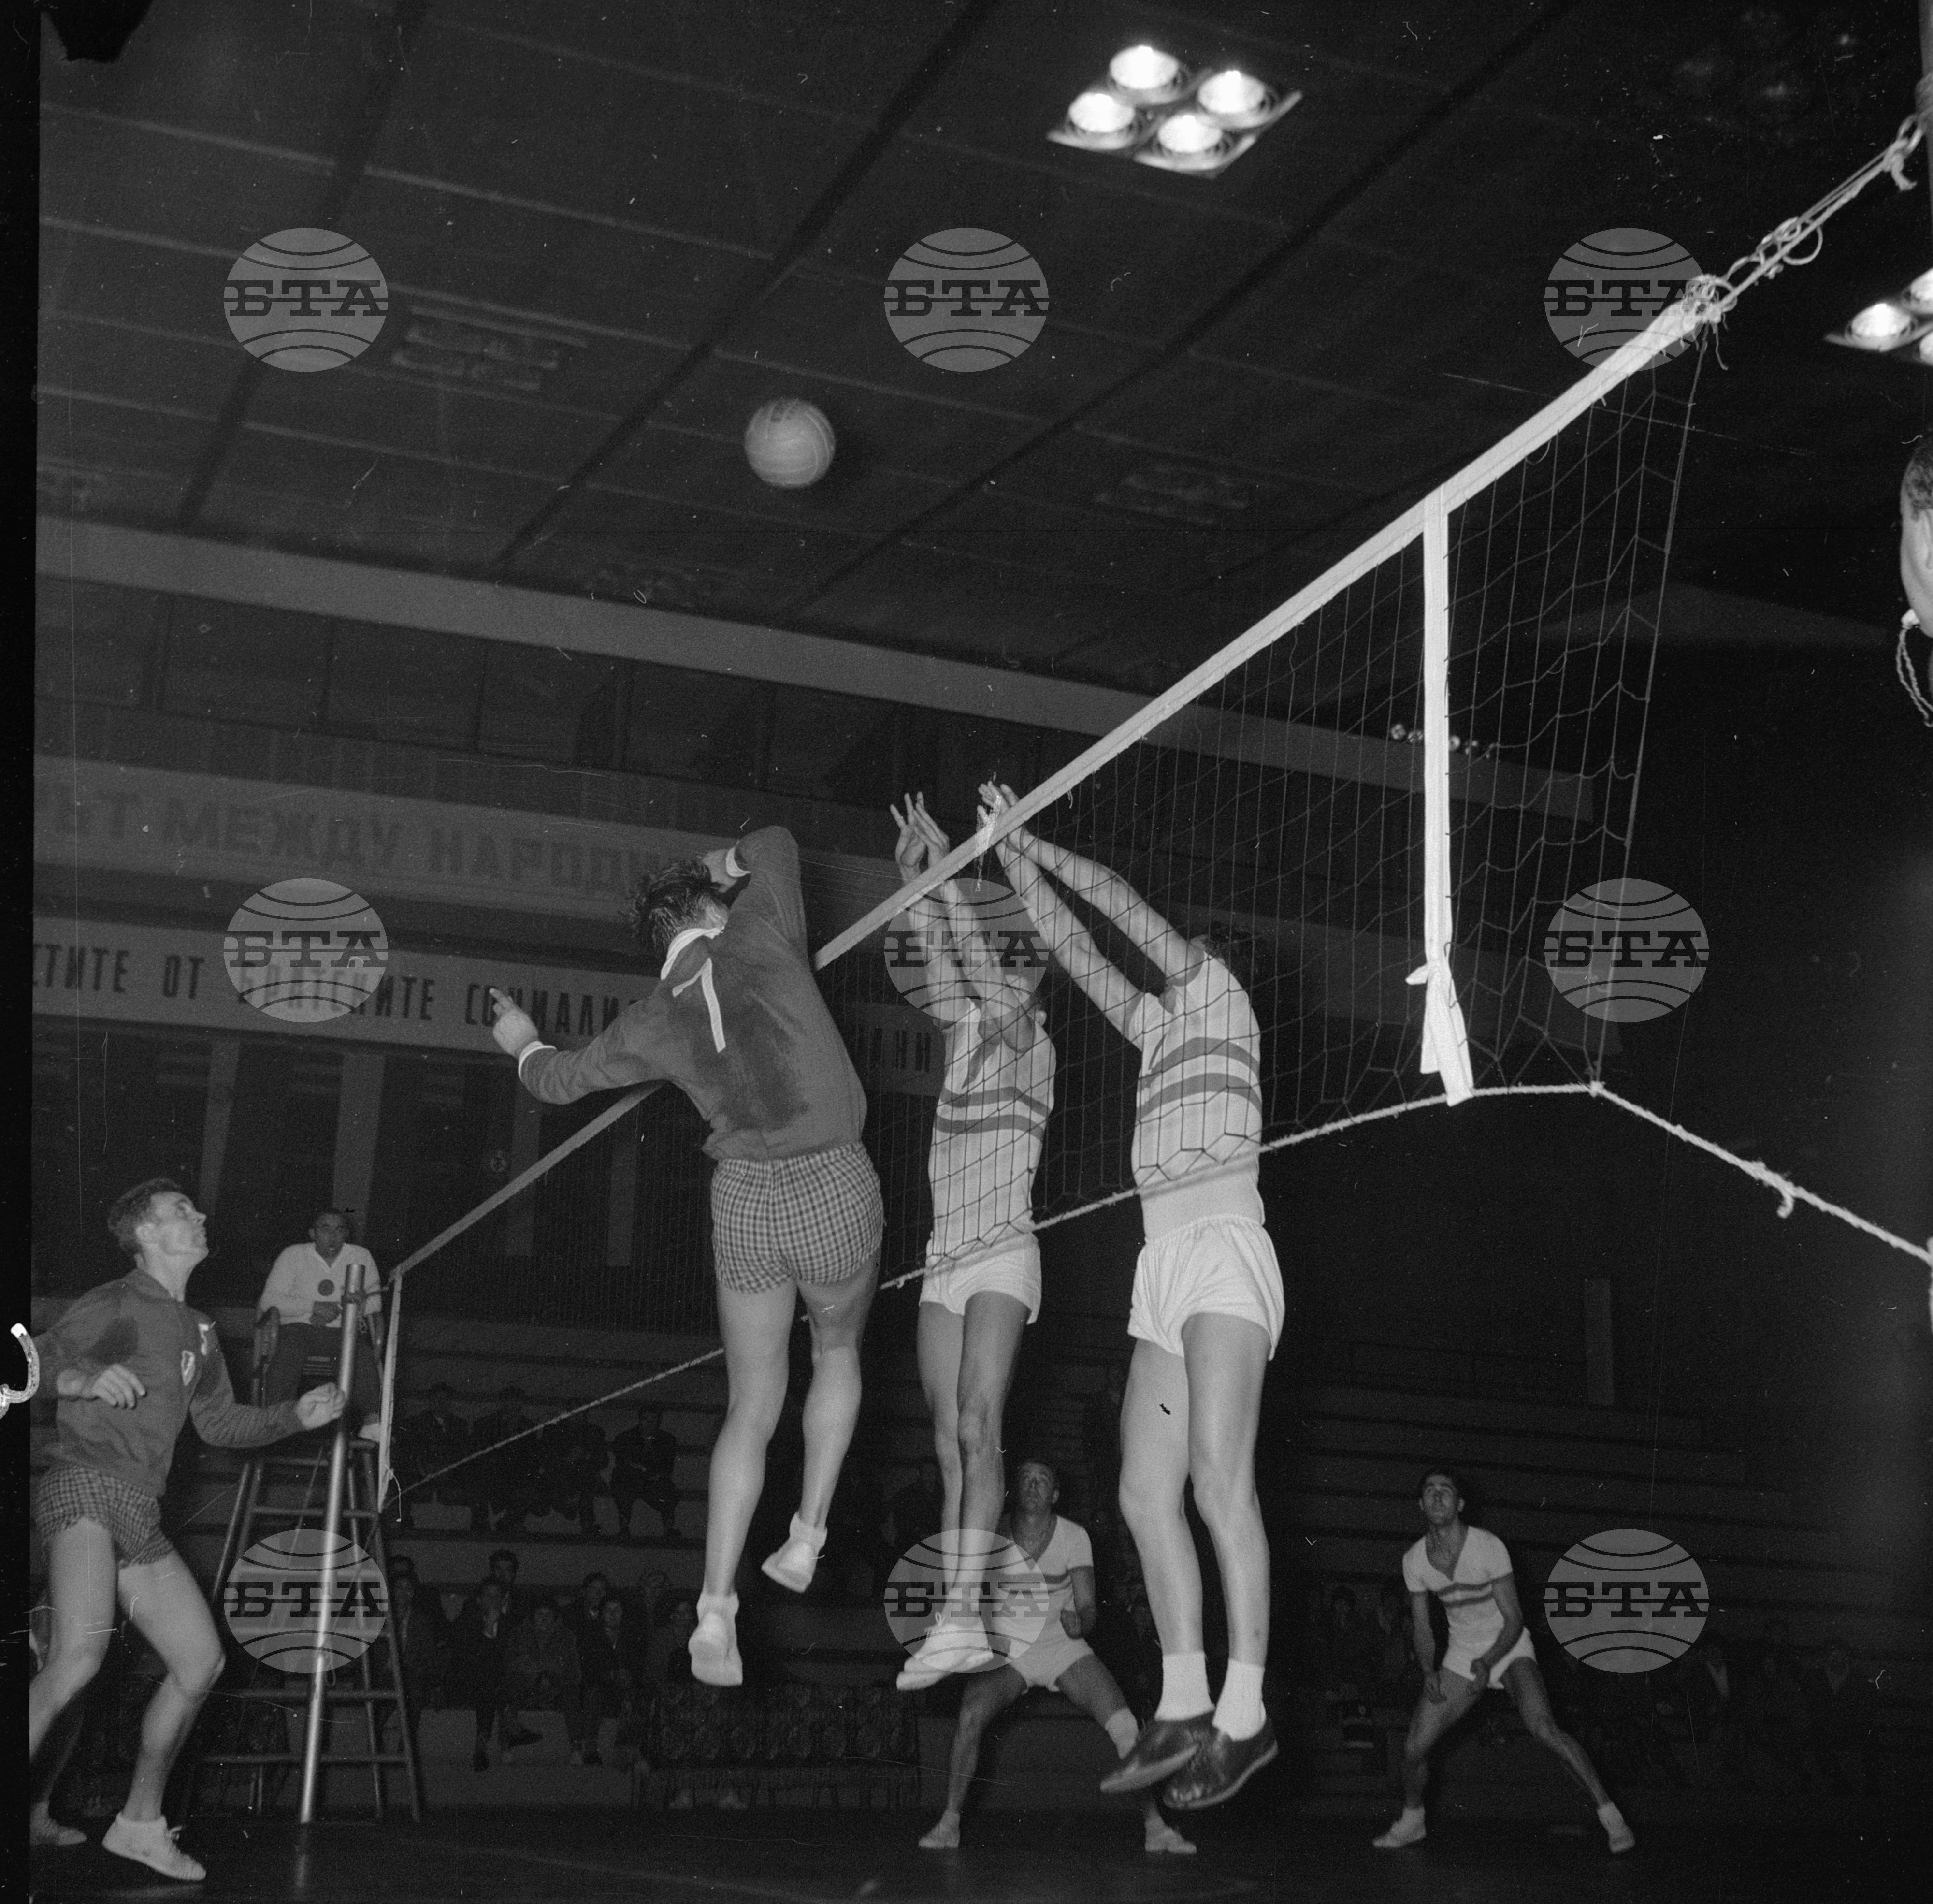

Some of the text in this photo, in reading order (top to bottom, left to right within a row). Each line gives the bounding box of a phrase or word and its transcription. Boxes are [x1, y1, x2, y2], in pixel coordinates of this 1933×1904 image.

[163, 798, 403, 869] МЕЖДУ
[163, 954, 205, 1000] ОТ
[465, 983, 638, 1036] СОИАЛИ
